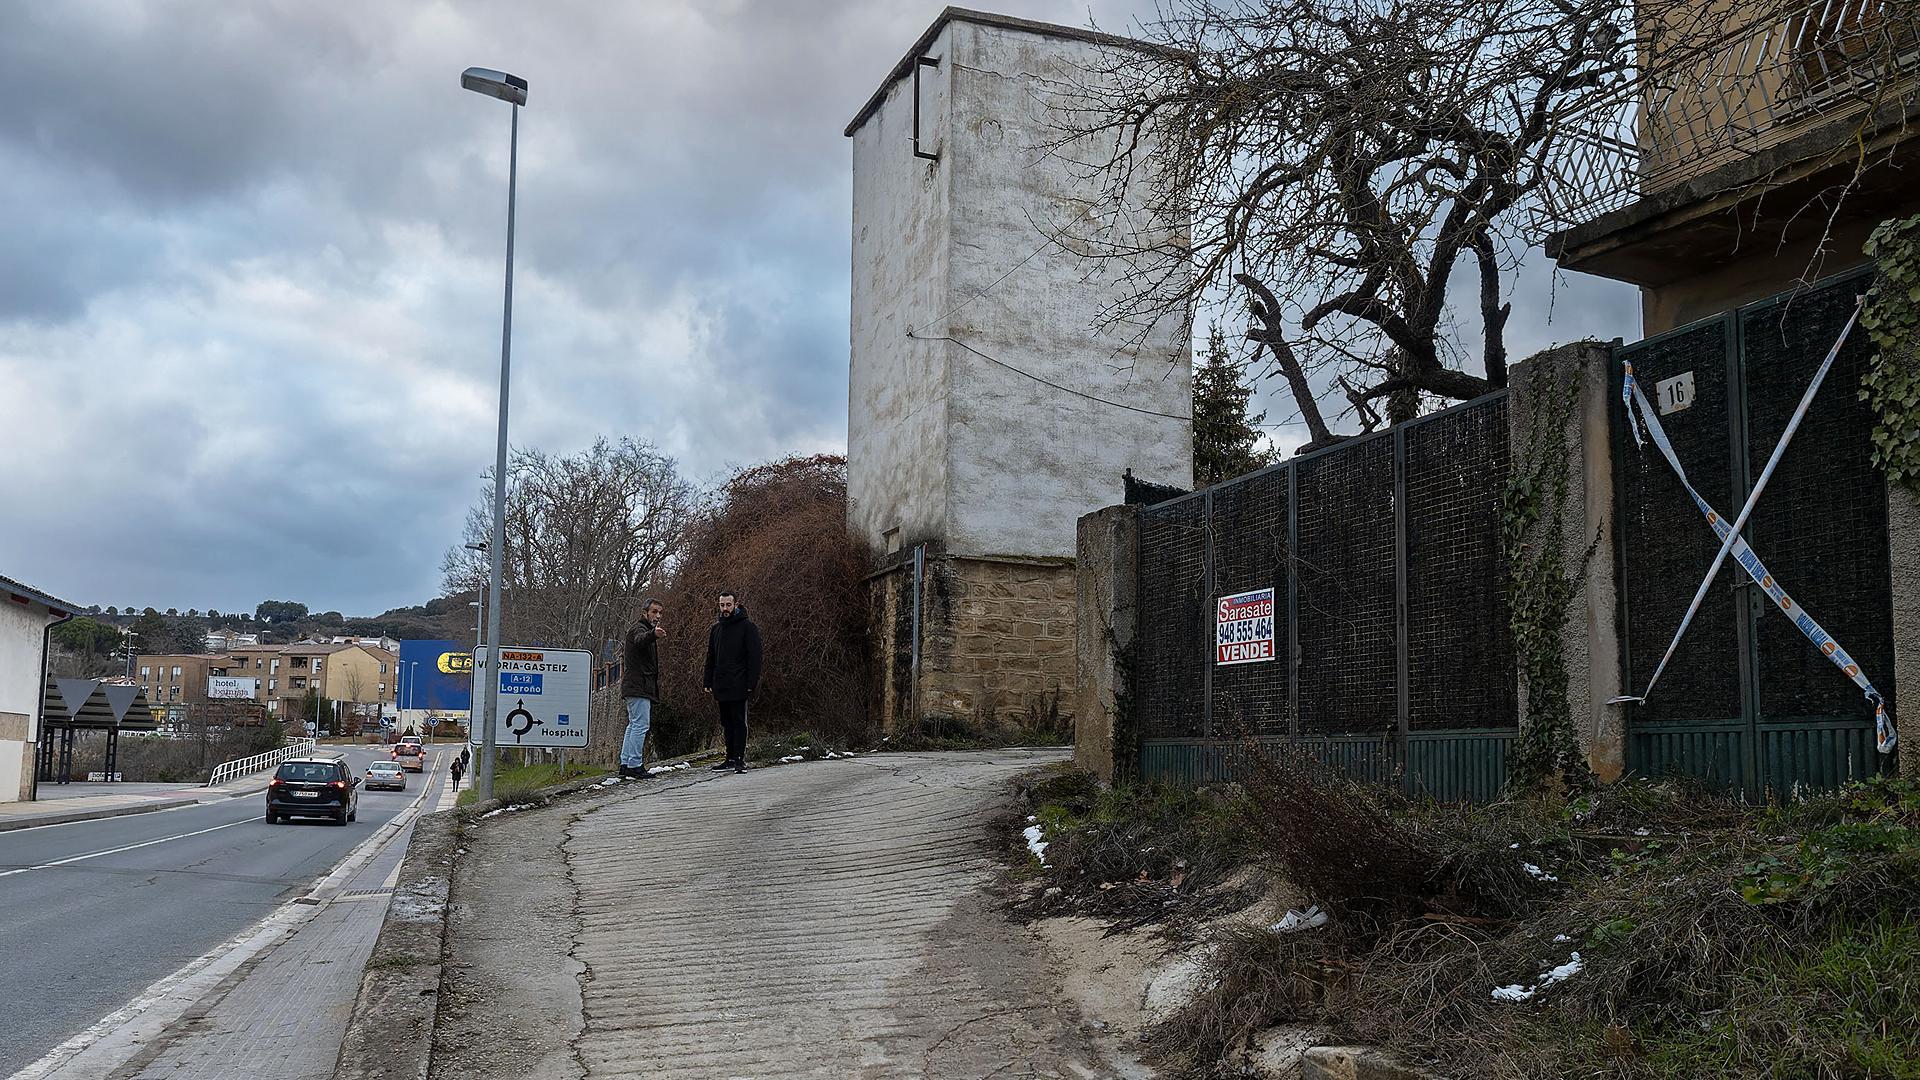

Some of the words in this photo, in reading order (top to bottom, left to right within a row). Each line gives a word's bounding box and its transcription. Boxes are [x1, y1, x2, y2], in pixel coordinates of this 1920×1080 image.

[1667, 381, 1685, 406] 16
[1232, 592, 1271, 604] INMOBILIARIA
[1219, 601, 1272, 621] Sarasate
[1219, 622, 1235, 644] 948
[1236, 620, 1253, 641] 555
[1255, 617, 1272, 639] 464
[503, 651, 543, 660] NA-132-A
[1221, 641, 1269, 661] VENDE
[215, 679, 237, 687] hotel
[501, 683, 541, 694] Logroño
[541, 728, 584, 738] Hospital
